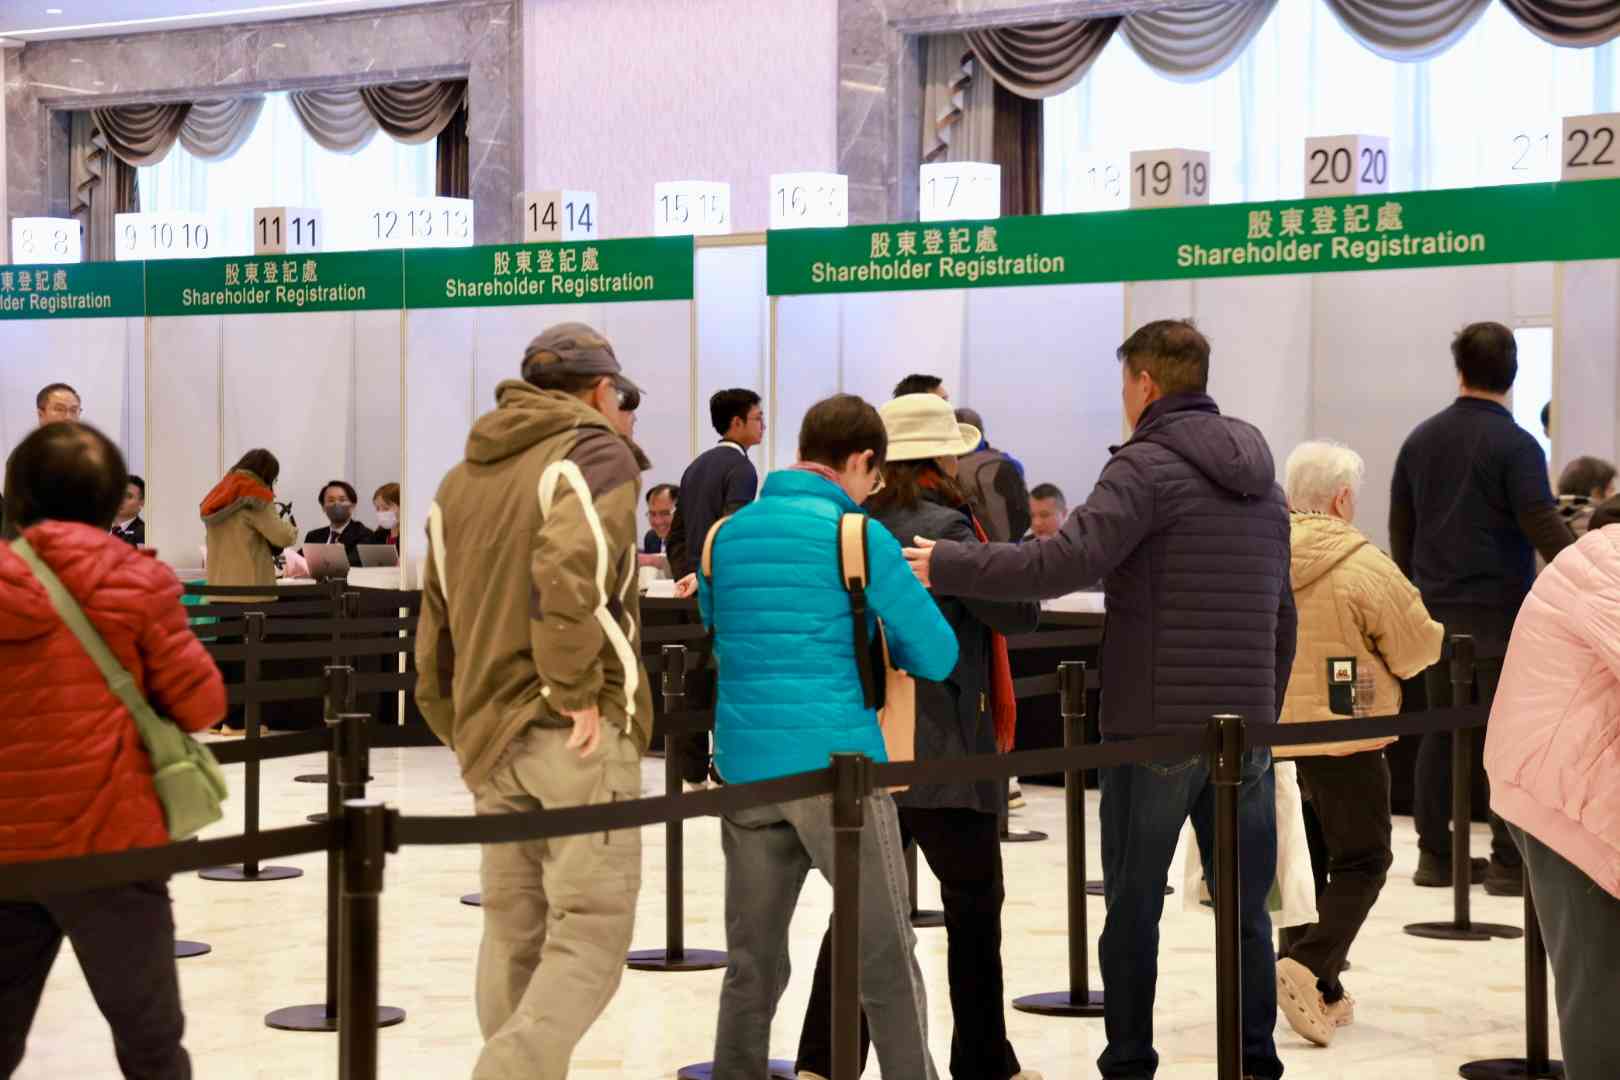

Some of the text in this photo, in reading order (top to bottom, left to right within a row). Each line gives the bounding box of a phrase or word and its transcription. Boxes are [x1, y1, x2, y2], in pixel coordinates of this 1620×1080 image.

[1566, 127, 1615, 168] 22
[1135, 161, 1172, 196] 19
[1182, 160, 1207, 196] 19
[1309, 148, 1352, 184] 20
[1361, 147, 1387, 184] 20
[927, 176, 960, 208] 17
[529, 202, 557, 232] 14
[565, 201, 593, 233] 14
[658, 193, 689, 224] 15
[1248, 203, 1402, 238] 股東登記處
[151, 222, 173, 250] 10
[181, 223, 209, 250] 10
[258, 216, 281, 245] 11
[292, 217, 316, 247] 11
[373, 210, 398, 240] 12
[871, 227, 997, 258] 股東登記處
[1178, 232, 1485, 266] Shareholder Registration
[226, 261, 317, 285] 股東登記處
[495, 248, 598, 275] 股東登記處
[813, 255, 1065, 282] Shareholder Registration
[183, 284, 366, 306] Shareholder Registration
[446, 272, 654, 297] Shareholder Registration
[31, 292, 111, 312] Registration
